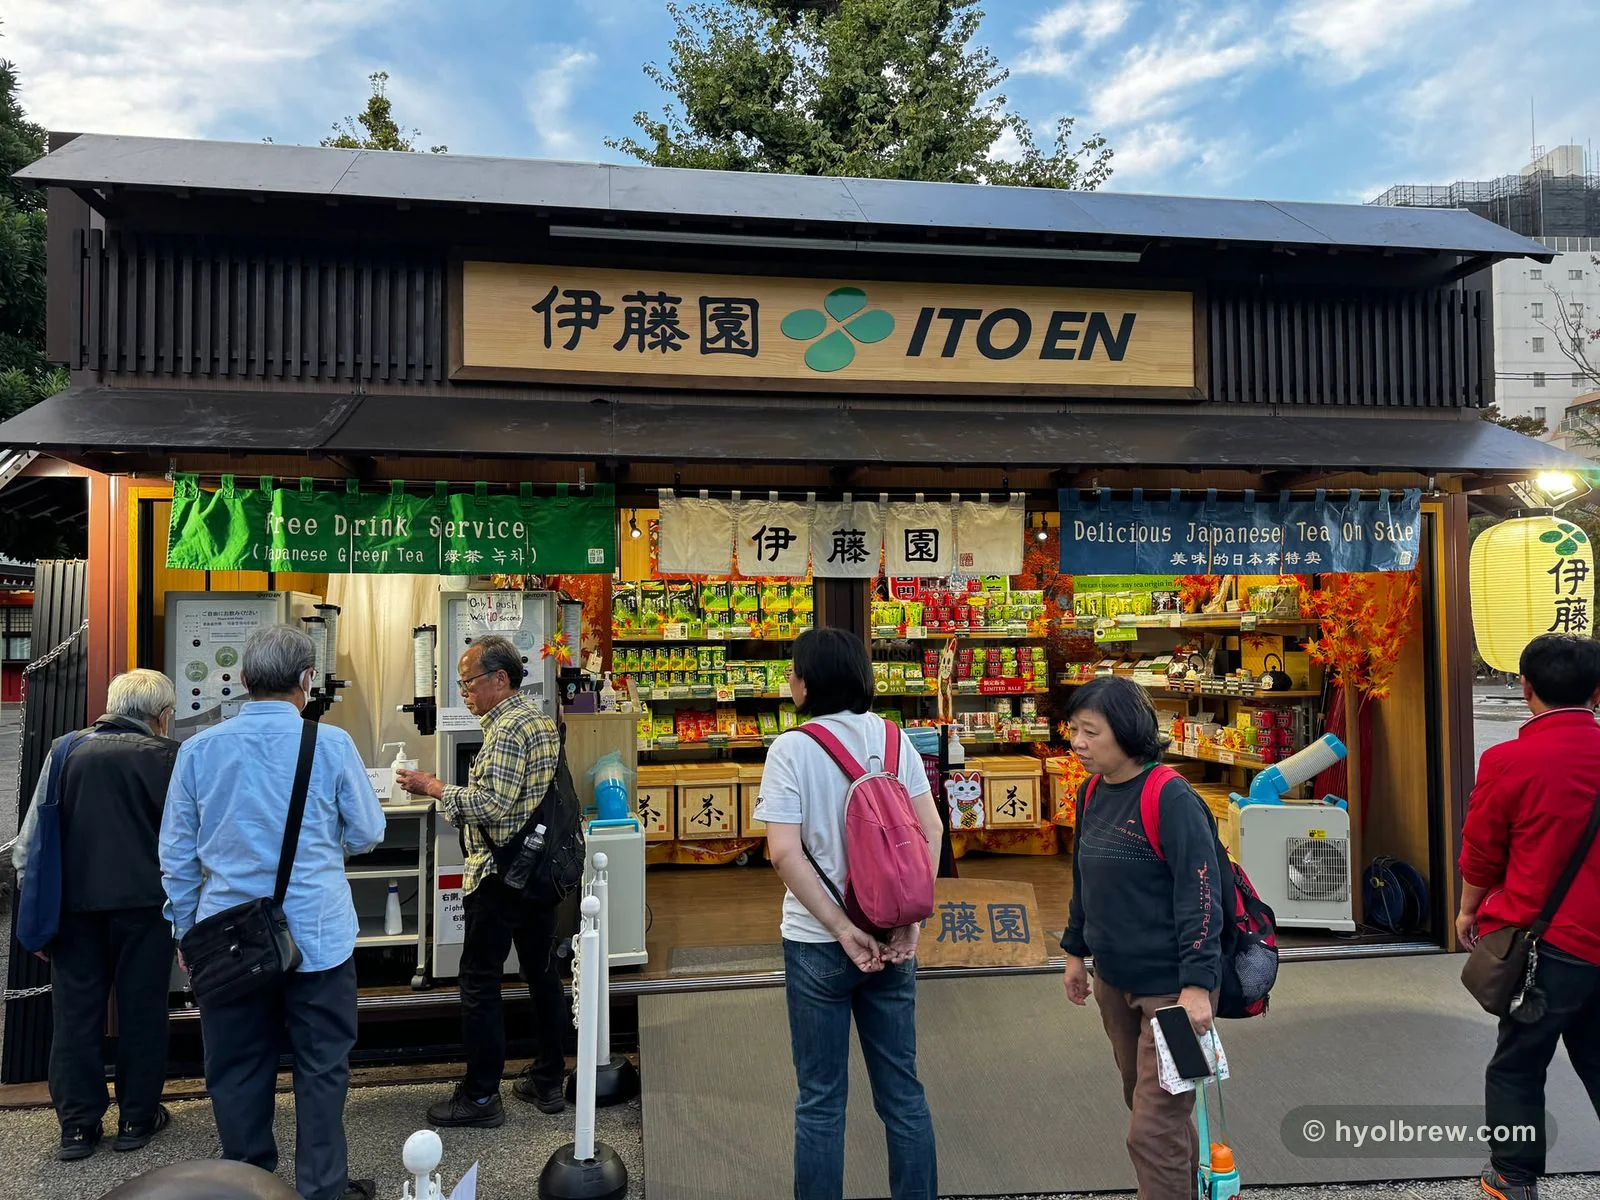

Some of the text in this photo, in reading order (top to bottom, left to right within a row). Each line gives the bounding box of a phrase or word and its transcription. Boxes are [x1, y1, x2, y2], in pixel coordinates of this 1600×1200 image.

[532, 285, 760, 358] 伊藤園
[906, 306, 1137, 362] ITO EN
[265, 511, 525, 539] Free Drink Service
[1074, 520, 1414, 546] Delicious Japanese Tea On Sale
[337, 547, 388, 562] Green
[396, 547, 424, 562] Tea
[752, 525, 939, 565] 伊藤園
[1170, 551, 1323, 567] 美味的日本茶特卖
[1546, 557, 1590, 633] 伊藤
[638, 794, 661, 828] 茶
[690, 793, 724, 828] 茶
[996, 785, 1028, 818] 茶
[920, 901, 1031, 945] 藤園
